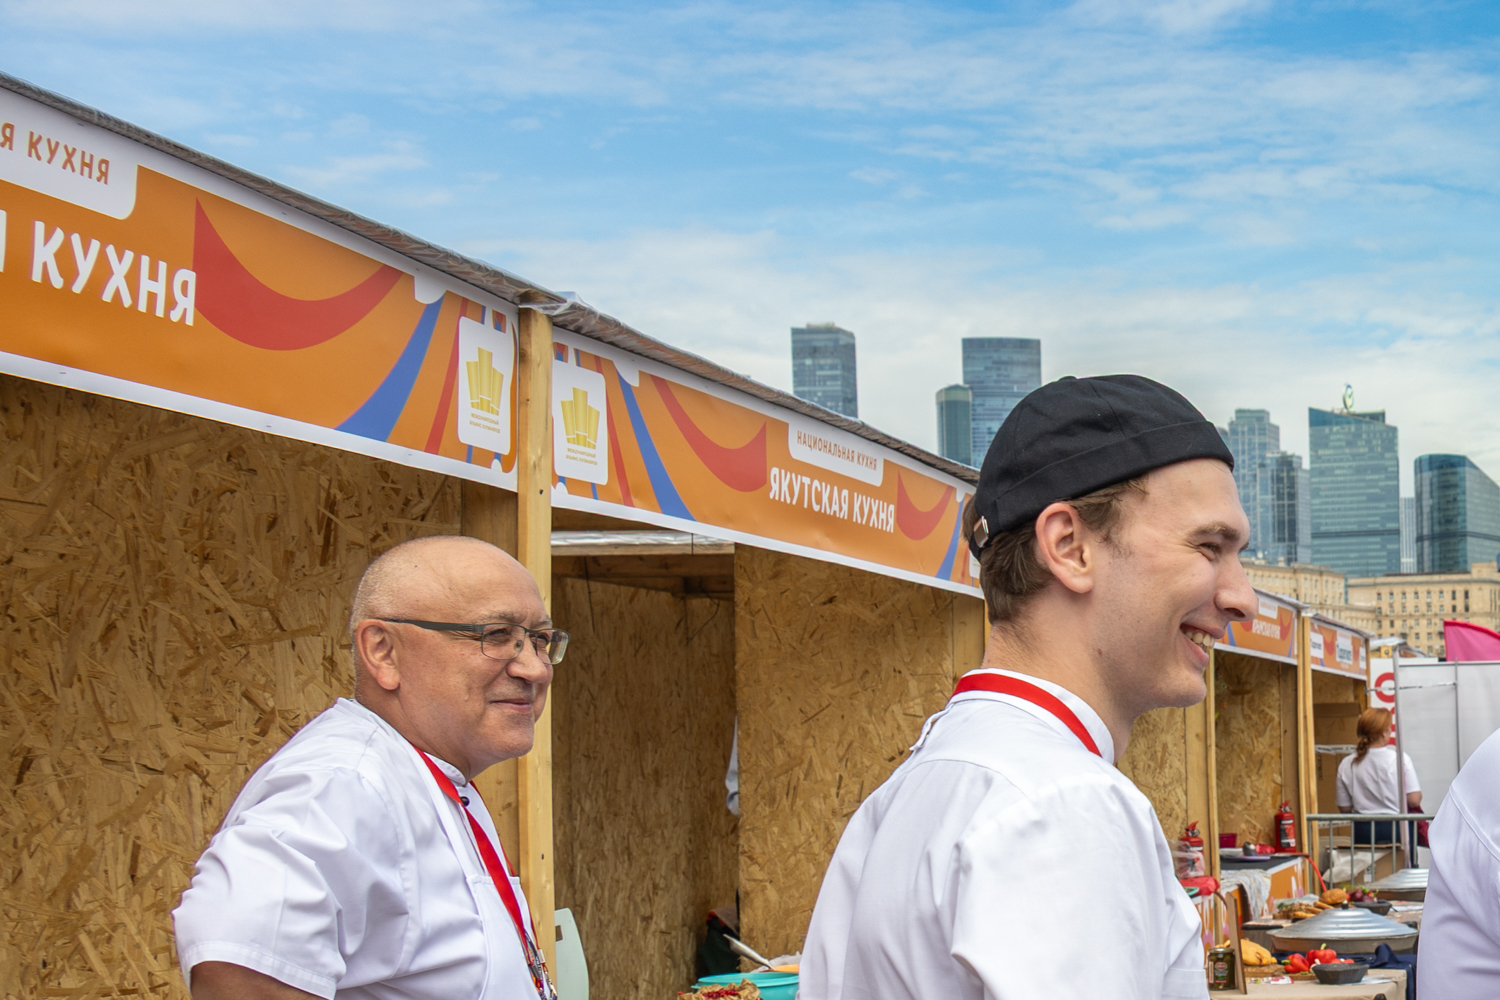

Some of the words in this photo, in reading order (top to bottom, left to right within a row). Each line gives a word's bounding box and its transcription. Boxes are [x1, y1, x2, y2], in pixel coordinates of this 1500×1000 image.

[27, 130, 110, 185] КУХНЯ
[31, 220, 197, 326] КУХНЯ
[797, 430, 855, 463] НАЦИОНАЛЬНАЯ
[857, 452, 877, 471] КУХНЯ
[769, 466, 849, 520] ЯКУТСКАЯ
[852, 492, 895, 533] КУХНЯ
